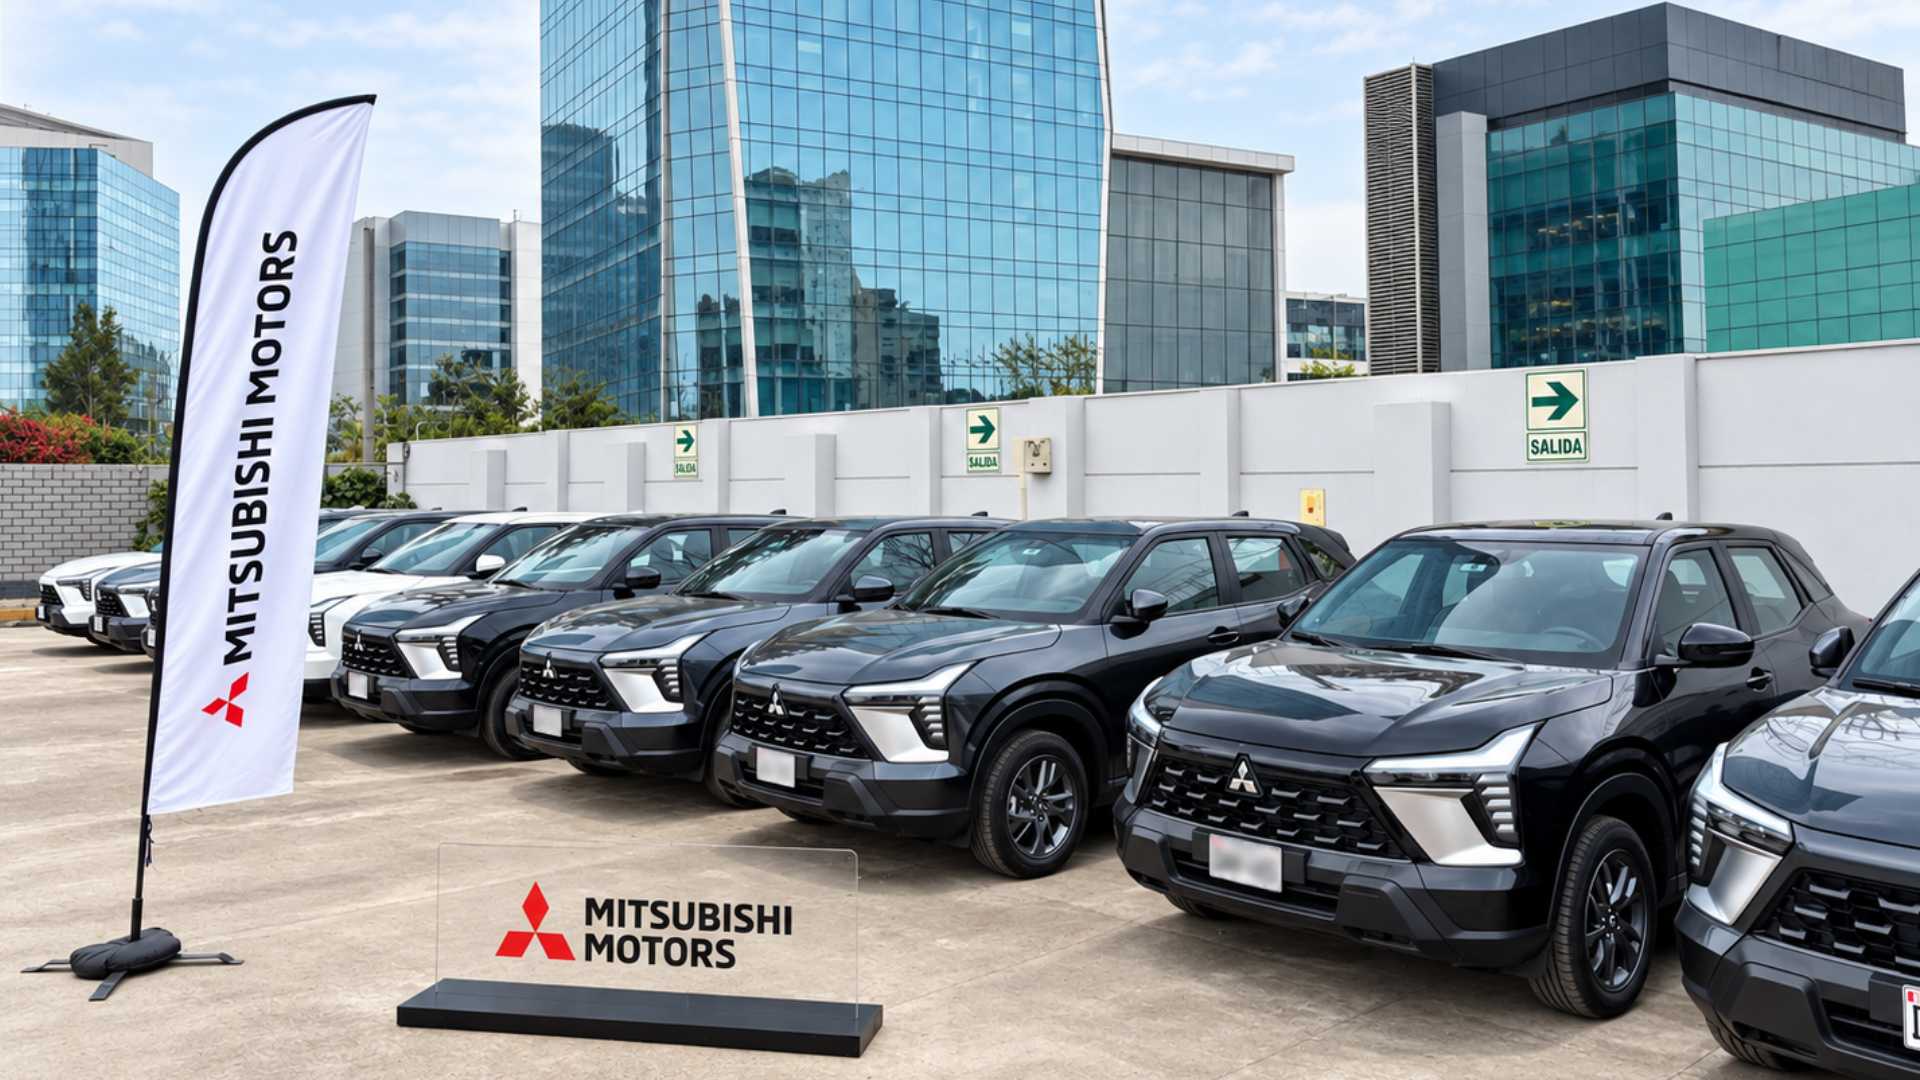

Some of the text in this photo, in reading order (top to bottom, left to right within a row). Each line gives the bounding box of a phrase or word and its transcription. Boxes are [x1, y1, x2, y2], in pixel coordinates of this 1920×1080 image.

[223, 230, 298, 666] MITSUBISHI MOTORS
[969, 456, 998, 468] SALIDA
[1530, 437, 1583, 456] SALIDA
[585, 897, 793, 936] MITSUBISHI
[585, 933, 736, 969] MOTORS
